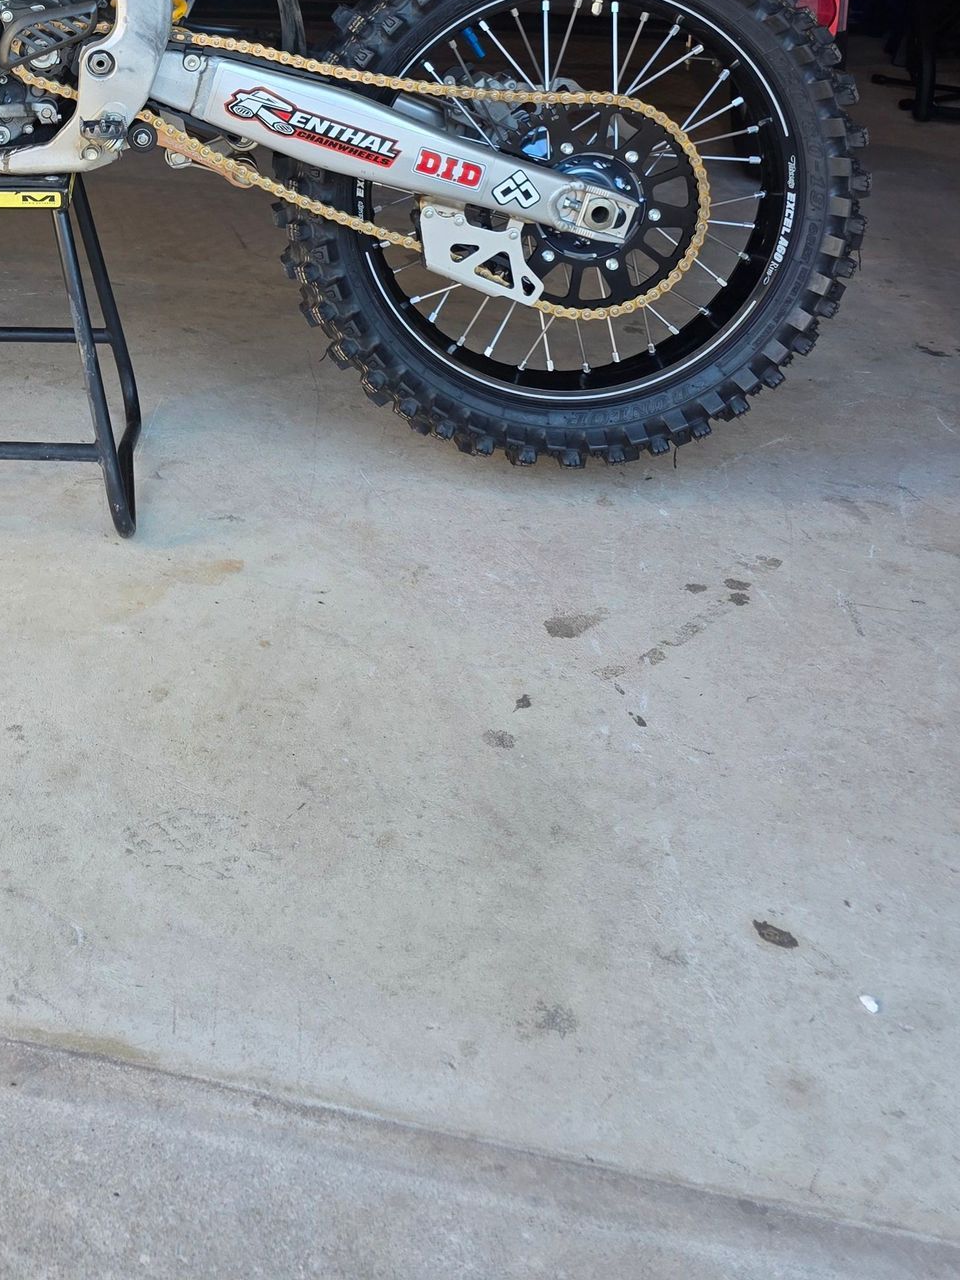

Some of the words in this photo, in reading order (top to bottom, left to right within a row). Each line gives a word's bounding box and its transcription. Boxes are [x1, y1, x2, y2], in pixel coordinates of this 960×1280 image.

[230, 90, 400, 157] RENTHAL
[295, 130, 392, 167] CHAINWHEELS
[782, 192, 797, 236] EXCEL
[775, 237, 790, 264] A60
